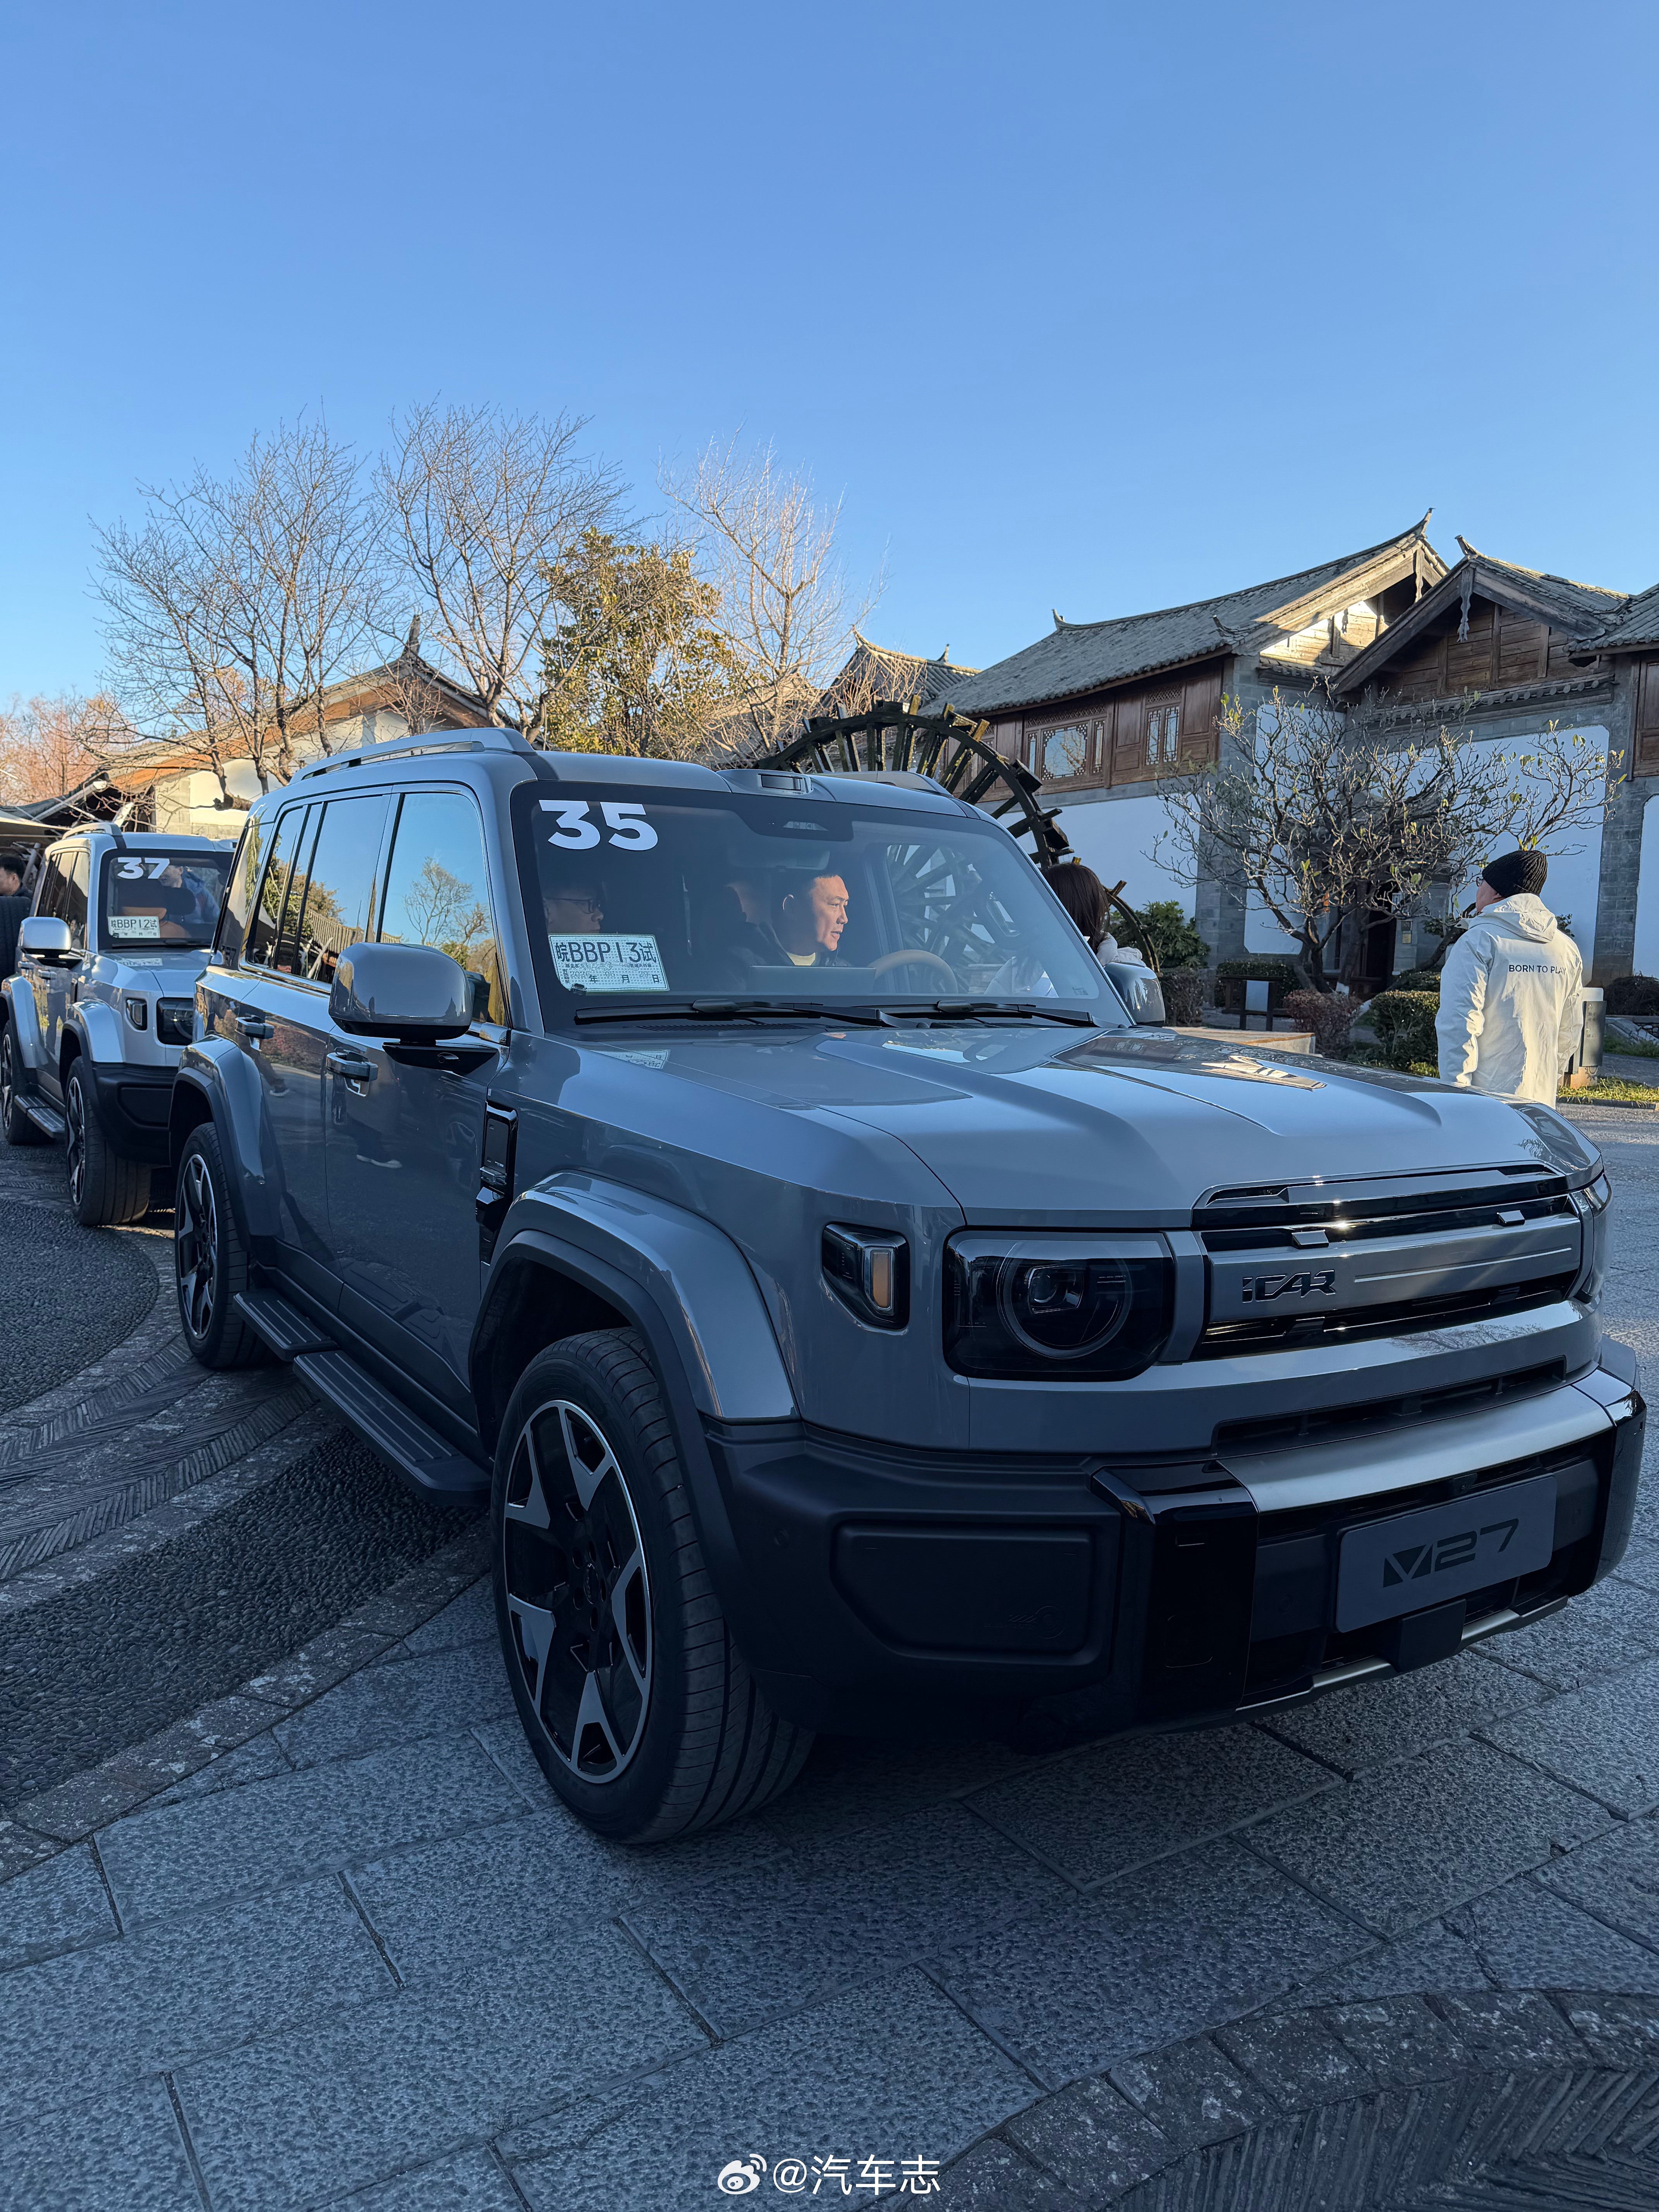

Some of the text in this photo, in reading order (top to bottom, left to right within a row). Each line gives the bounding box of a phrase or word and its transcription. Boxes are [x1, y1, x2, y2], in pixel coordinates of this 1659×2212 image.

[539, 800, 658, 851] 35
[117, 857, 170, 879] 37
[555, 942, 656, 963] 皖BBP13试
[1551, 966, 1566, 975] PLAY
[1383, 1518, 1519, 1587] V27
